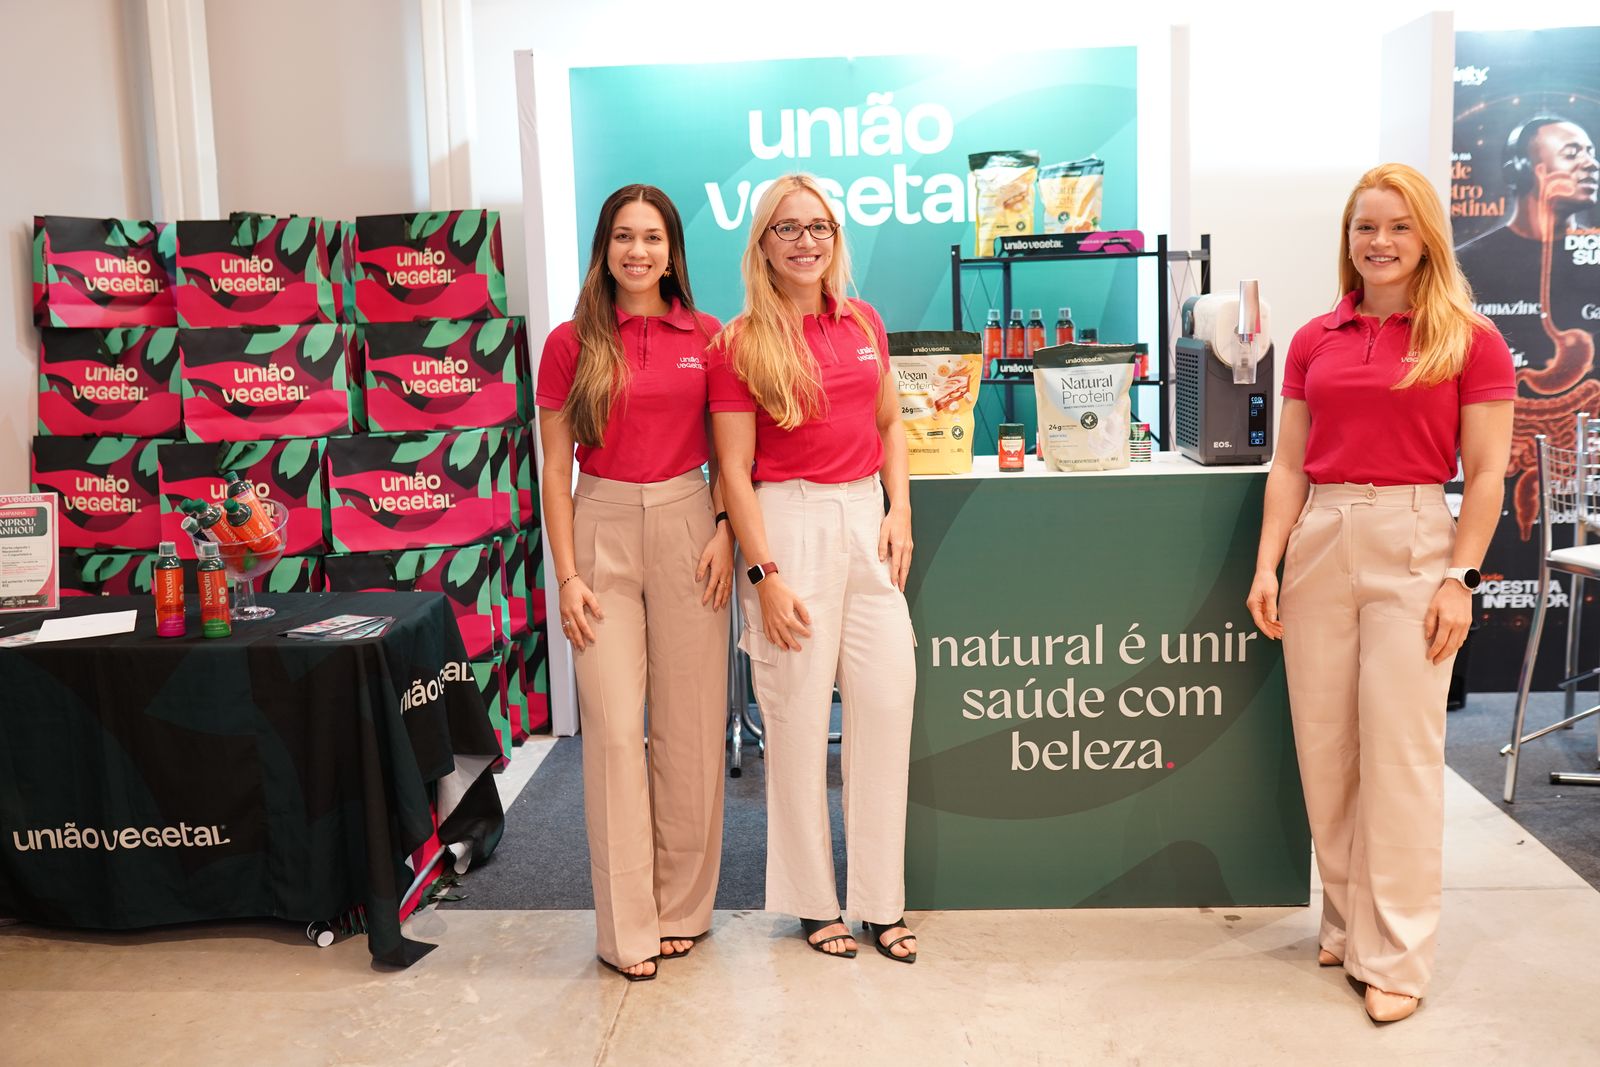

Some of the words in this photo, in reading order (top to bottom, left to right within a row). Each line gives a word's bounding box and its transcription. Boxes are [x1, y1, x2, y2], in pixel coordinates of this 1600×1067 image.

[748, 91, 954, 159] união
[1451, 184, 1483, 200] tro
[1451, 197, 1505, 217] stinal
[95, 256, 151, 274] união
[221, 255, 274, 273] união
[397, 247, 445, 267] união
[84, 275, 164, 293] vegetal
[209, 274, 286, 292] vegetal
[386, 267, 456, 286] vegetal
[85, 364, 138, 382] união
[233, 362, 295, 383] união
[413, 356, 469, 376] união
[1000, 363, 1024, 373] união
[401, 375, 482, 395] vegetal
[897, 370, 928, 382] Vegan
[898, 380, 935, 391] Protein
[1061, 374, 1113, 390] Natural
[72, 383, 149, 401] vegetal
[221, 383, 311, 404] vegetal
[1062, 389, 1114, 405] Protein
[75, 474, 130, 493] união
[381, 471, 441, 492] união
[64, 494, 142, 513] vegetal
[369, 491, 456, 513] vegetal
[0, 517, 36, 527] MPROU,
[931, 623, 1103, 667] natural
[1118, 622, 1146, 665] é
[1160, 621, 1257, 664] unir
[400, 678, 439, 716] nião
[962, 677, 1105, 720] saúde
[1118, 684, 1222, 718] com
[1011, 730, 1175, 771] beleza.
[12, 822, 100, 852] união
[100, 822, 231, 852] vegetal
